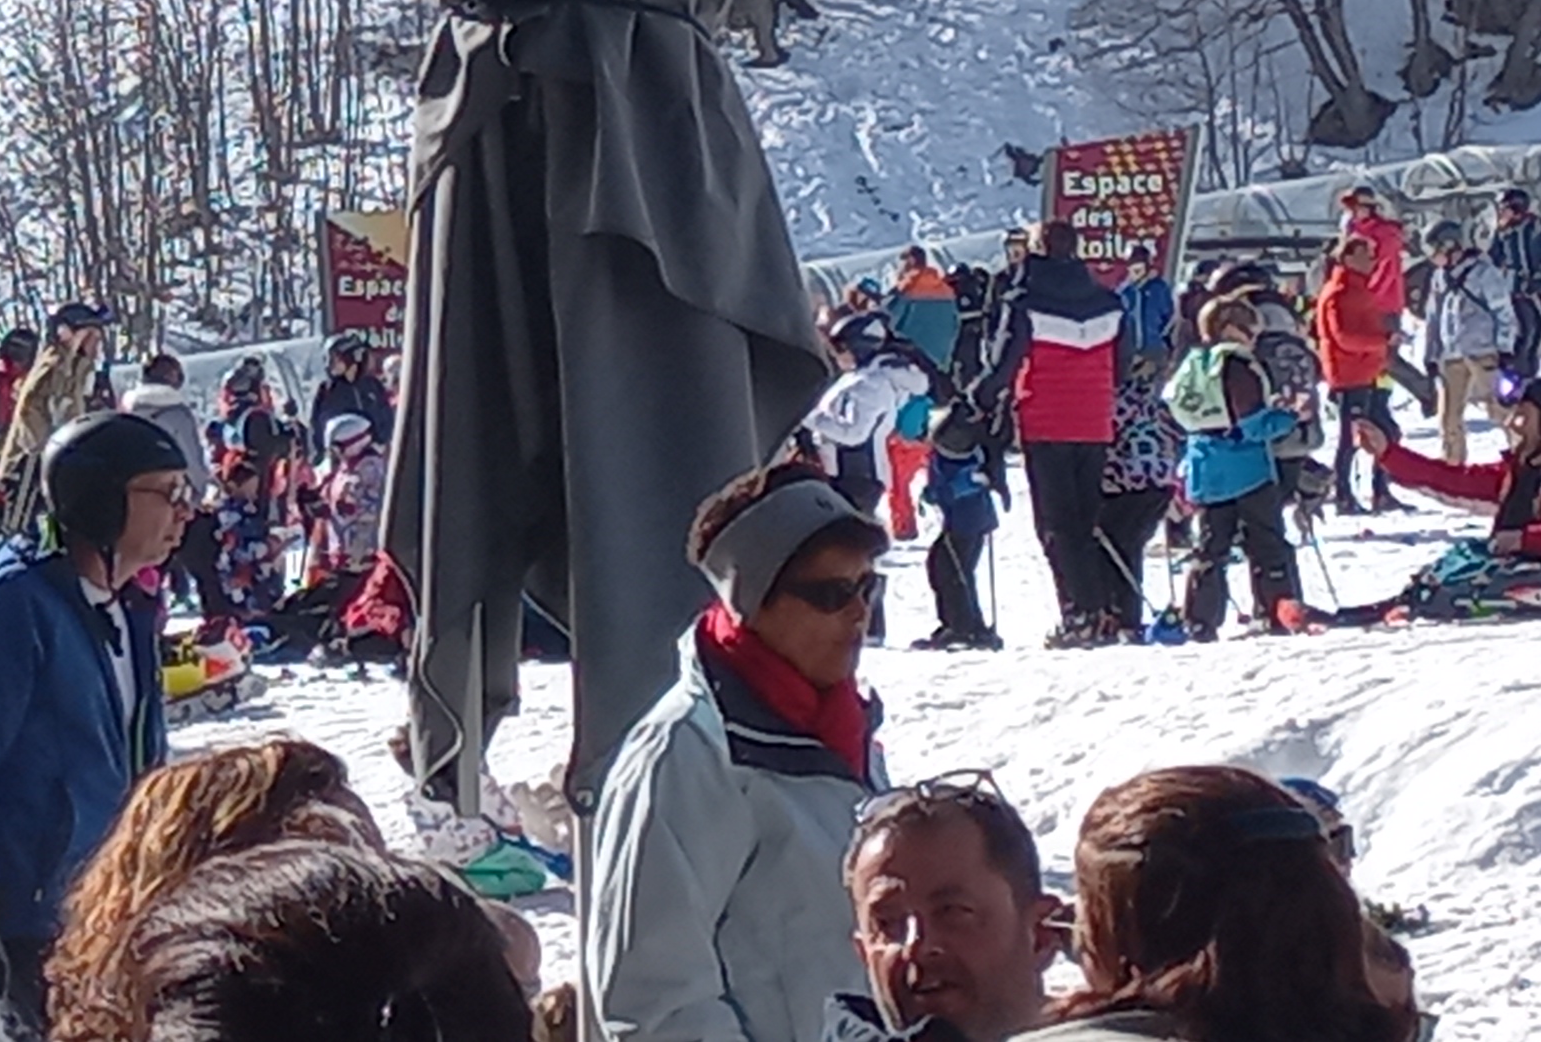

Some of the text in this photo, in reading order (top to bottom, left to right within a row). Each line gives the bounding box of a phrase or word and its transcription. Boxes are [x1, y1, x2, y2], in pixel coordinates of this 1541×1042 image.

[1063, 170, 1163, 198] Espace
[1072, 208, 1113, 228] des
[337, 274, 407, 301] Espac
